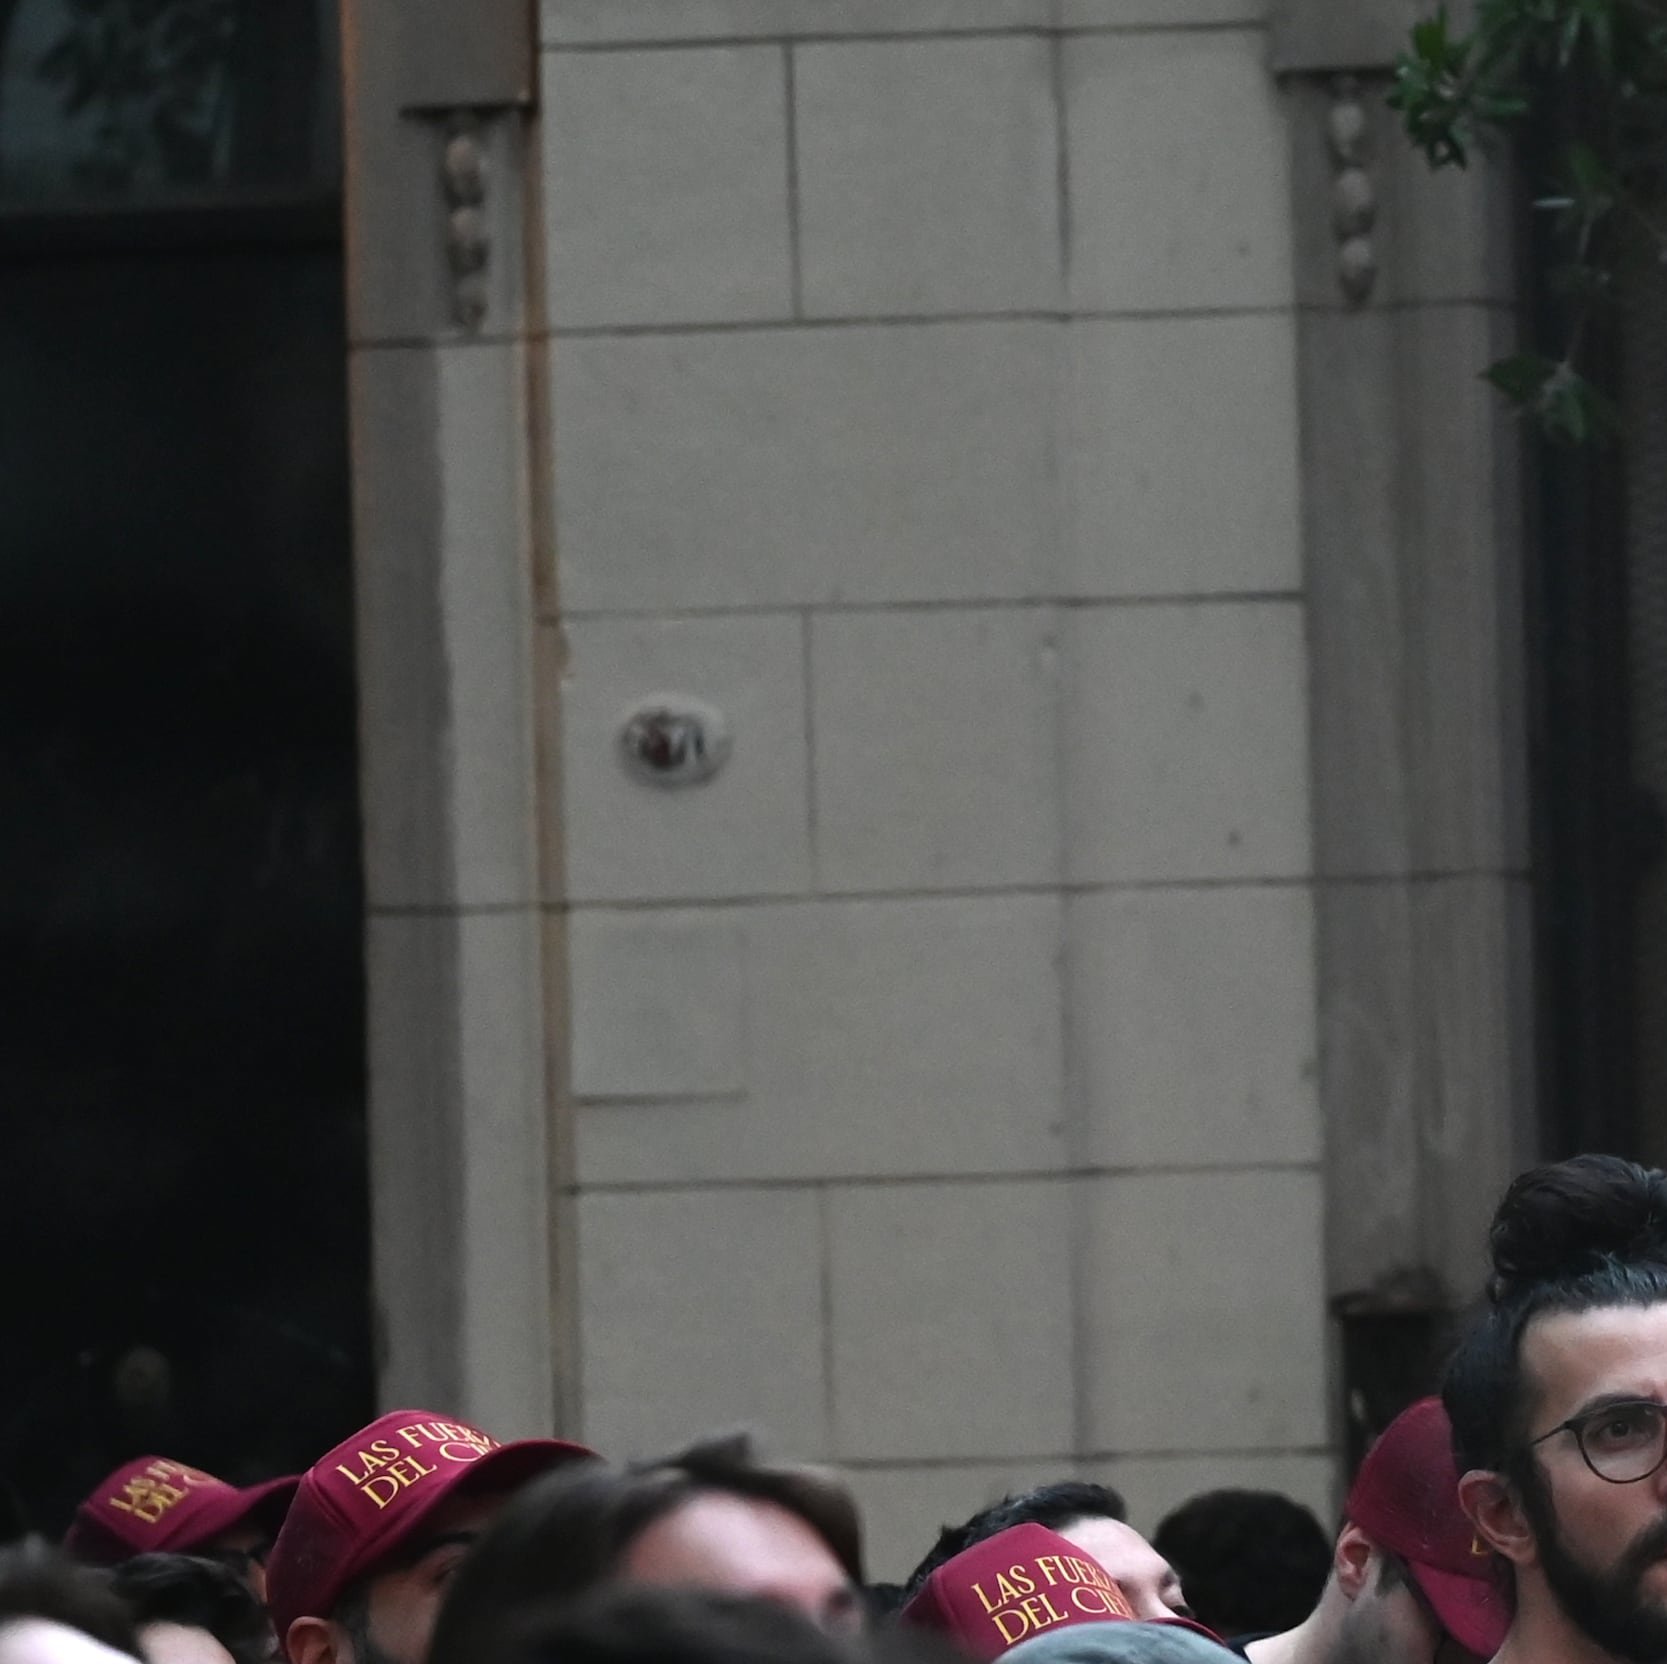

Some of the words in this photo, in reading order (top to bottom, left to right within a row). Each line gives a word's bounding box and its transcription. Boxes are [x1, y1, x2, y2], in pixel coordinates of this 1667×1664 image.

[336, 1439, 401, 1486] LAS
[361, 1455, 438, 1510] DEL
[971, 1564, 1036, 1614] LAS
[991, 1592, 1070, 1646] DEL
